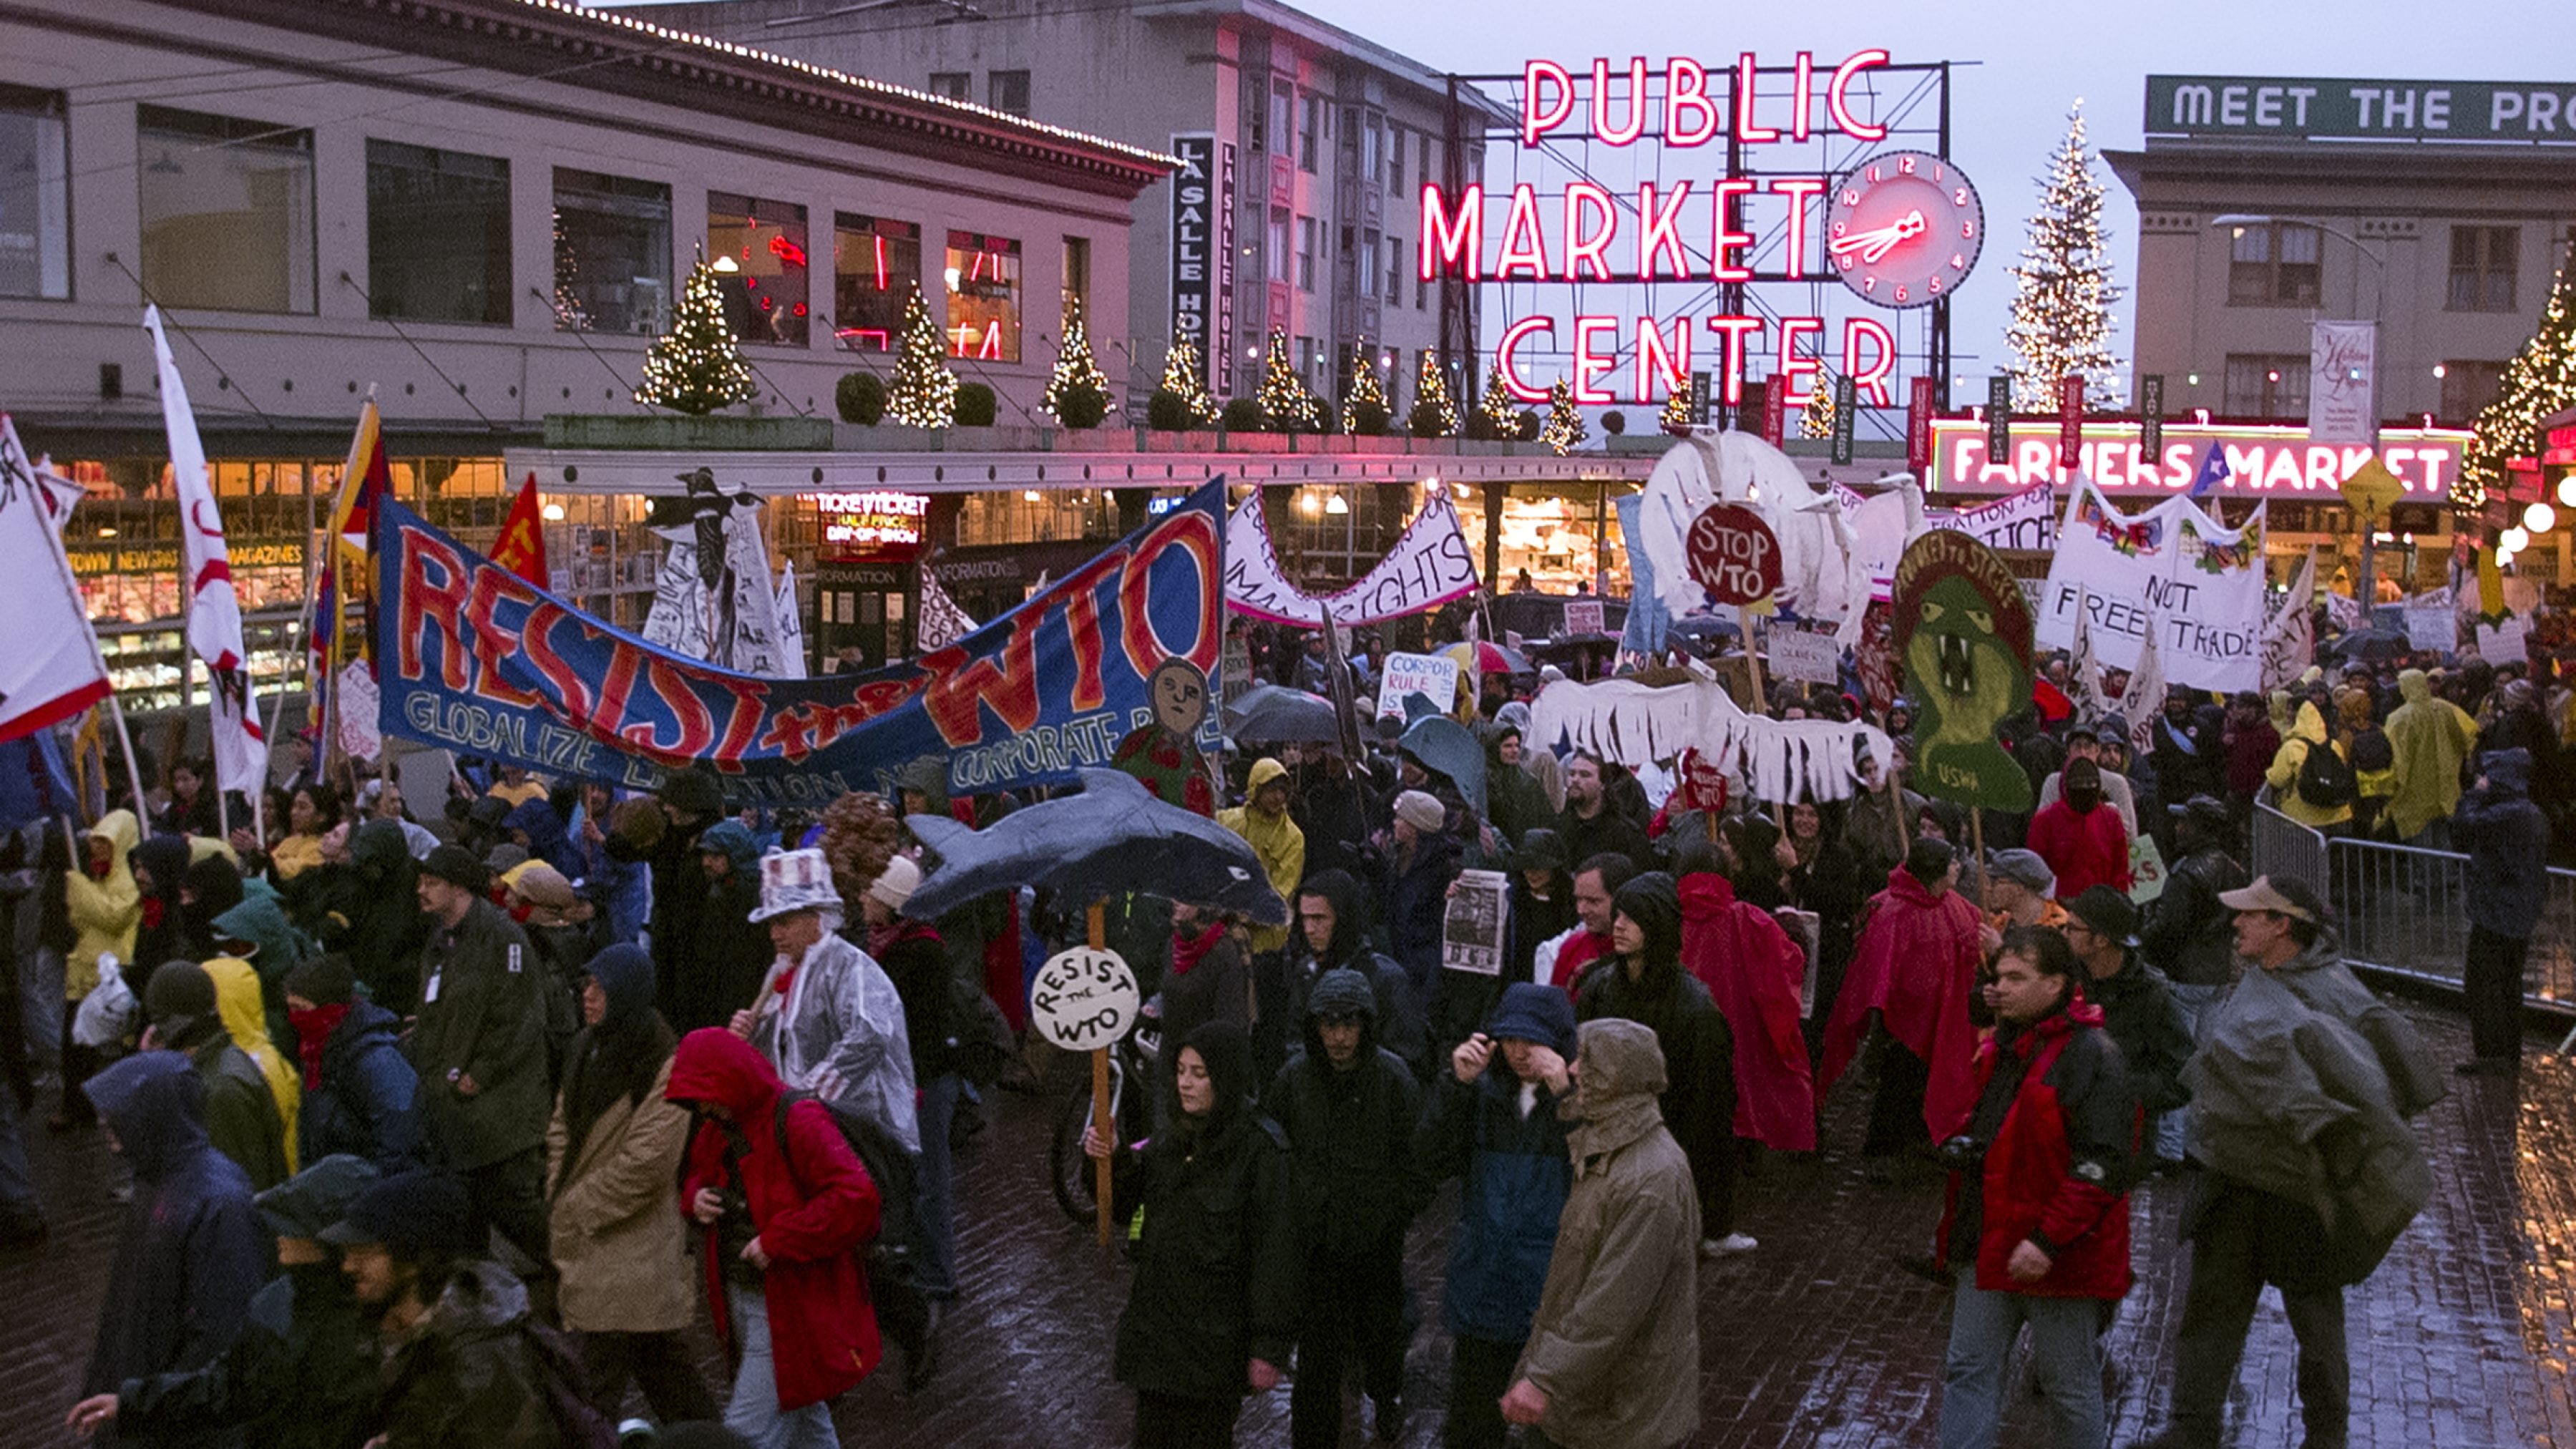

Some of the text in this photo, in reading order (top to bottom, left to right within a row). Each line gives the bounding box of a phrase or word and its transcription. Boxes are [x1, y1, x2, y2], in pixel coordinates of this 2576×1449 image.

[1523, 49, 1890, 148] PUBLIC
[2172, 84, 2317, 127] MEET
[2350, 88, 2451, 130] THE
[1180, 142, 1205, 179] LA
[1866, 165, 1881, 183] 11
[1899, 156, 1916, 174] 12
[1933, 165, 1941, 182] 1
[1843, 190, 1860, 206] 10
[1954, 187, 1967, 205] 2
[1178, 186, 1206, 281] SALLE
[1419, 178, 1826, 283] MARKET
[1834, 221, 1846, 238] 9
[1962, 220, 1974, 240] 3
[1219, 147, 1234, 388] LA SALLE HOTEL
[1841, 255, 1854, 271] 8
[1951, 253, 1963, 269] 4
[1864, 276, 1876, 293] 7
[1896, 285, 1908, 303] 6
[1928, 275, 1941, 294] 5
[1495, 317, 1898, 407] CENTER
[2225, 442, 2450, 492] MARKET
[1695, 515, 1770, 571] STOP
[1699, 556, 1762, 595] WTO
[2146, 575, 2198, 613] NOT
[2056, 587, 2145, 636] FREE
[2170, 620, 2254, 658] TRADE
[399, 525, 771, 774] RESIST
[917, 509, 1220, 748] WTO
[1382, 694, 1398, 708] IS
[1388, 673, 1430, 692] RULE
[405, 691, 601, 776] GLOBALIZE
[952, 711, 1120, 789] CORPORATE
[1034, 956, 1133, 1015] RESIST
[1066, 987, 1096, 1004] THE
[1053, 1006, 1121, 1043] WTO
